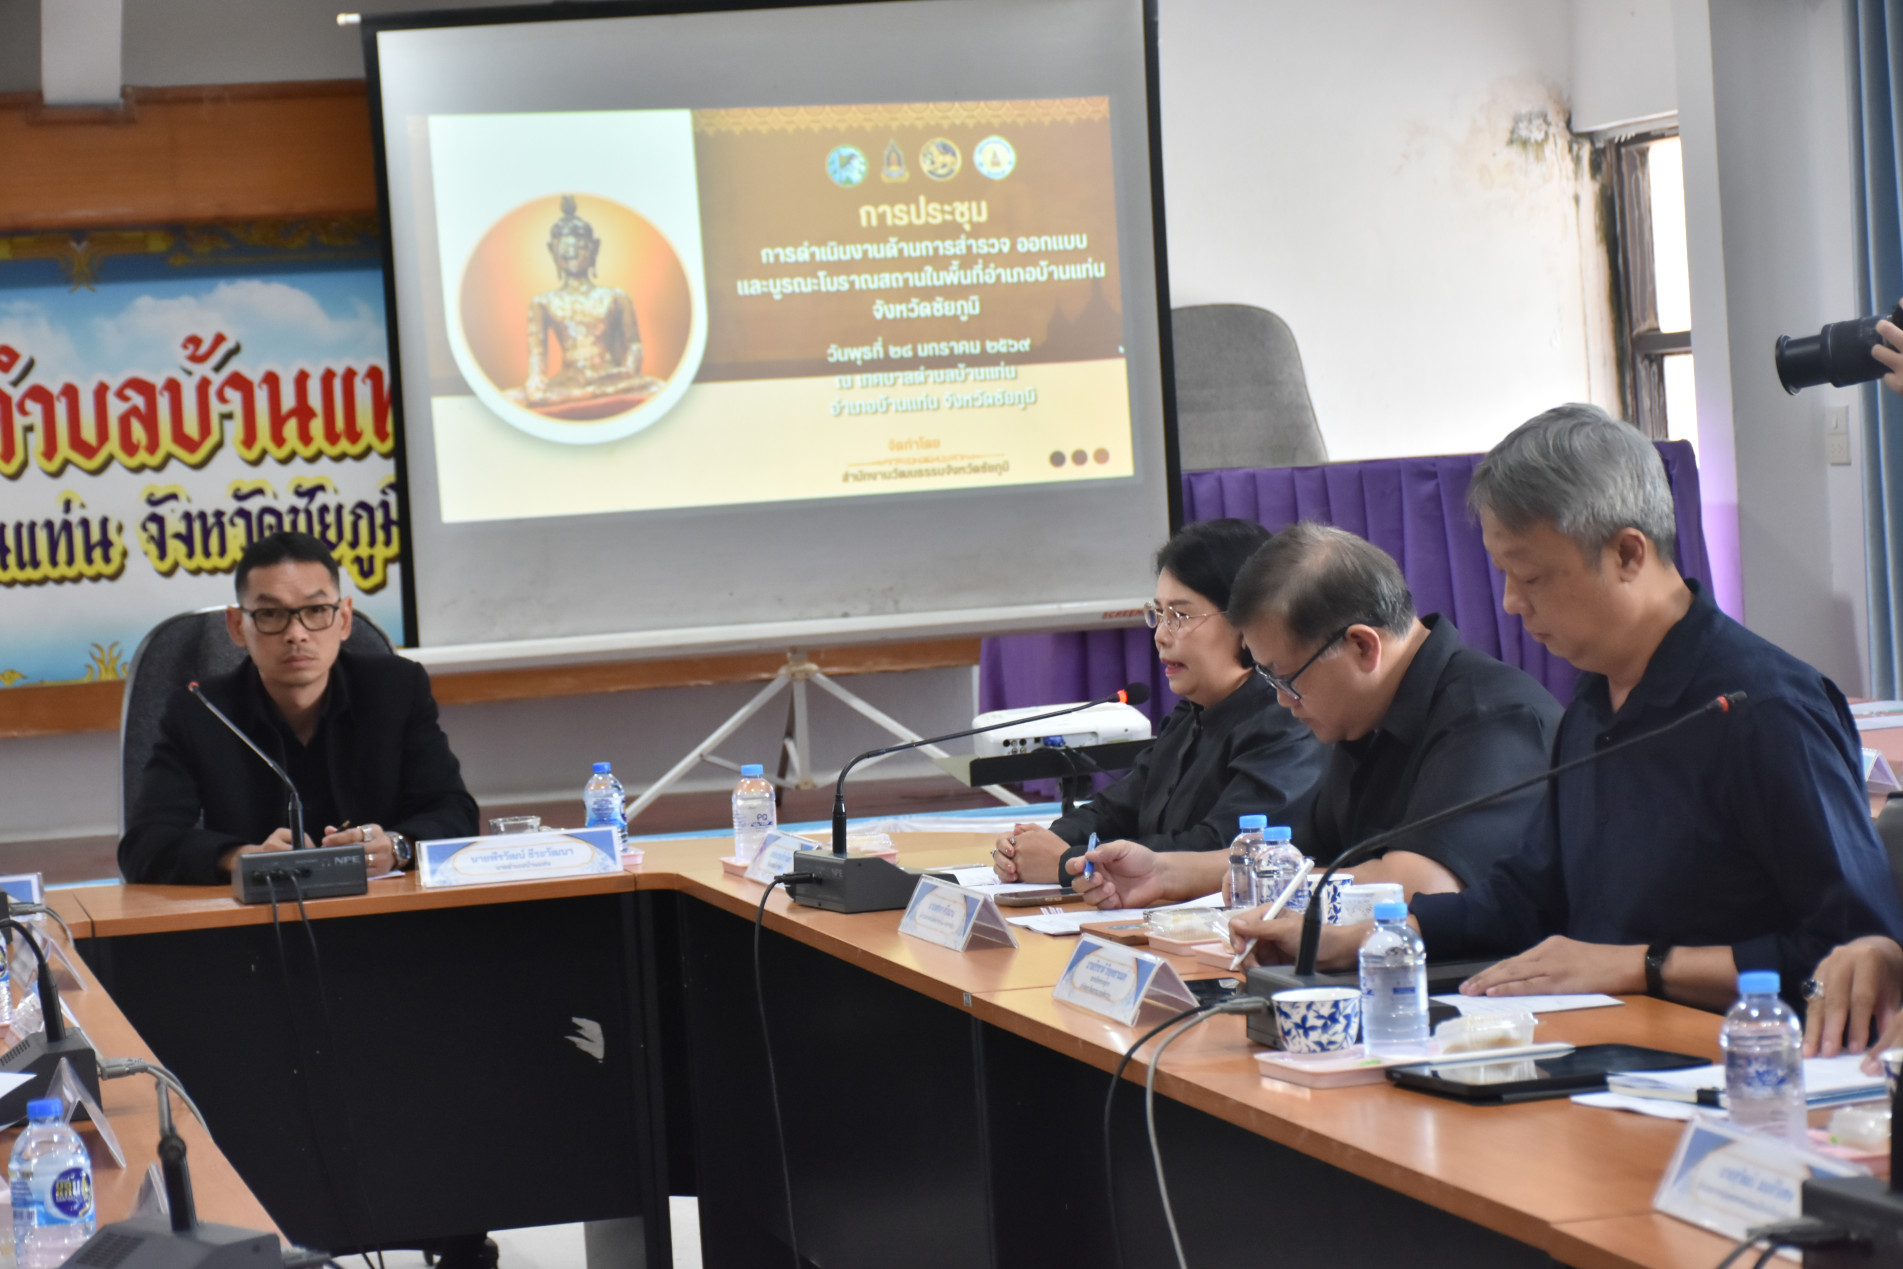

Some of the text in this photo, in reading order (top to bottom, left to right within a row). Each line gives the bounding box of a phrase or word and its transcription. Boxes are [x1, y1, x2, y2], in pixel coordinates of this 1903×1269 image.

[859, 195, 988, 232] การประชุม
[761, 232, 1088, 264] การดำเนินงานด้านการสำรวจ ออกแบบ
[736, 256, 1106, 300] และบูรณะโบราณสถานในพื้นที่อำเภอบ้านแท่น
[872, 295, 981, 322] จังหวัดชัยภูมิ
[827, 337, 884, 366] วันพุธที่
[917, 338, 981, 357] มกราคม
[985, 336, 1031, 354] ๒๕๖๙
[836, 361, 1017, 390] ณ เทศบาลตำบลบ้านแท่น
[830, 387, 1038, 416] อำเภอบ้านแท่น จังหวัดชัยภูมิ
[334, 855, 361, 865] NPE
